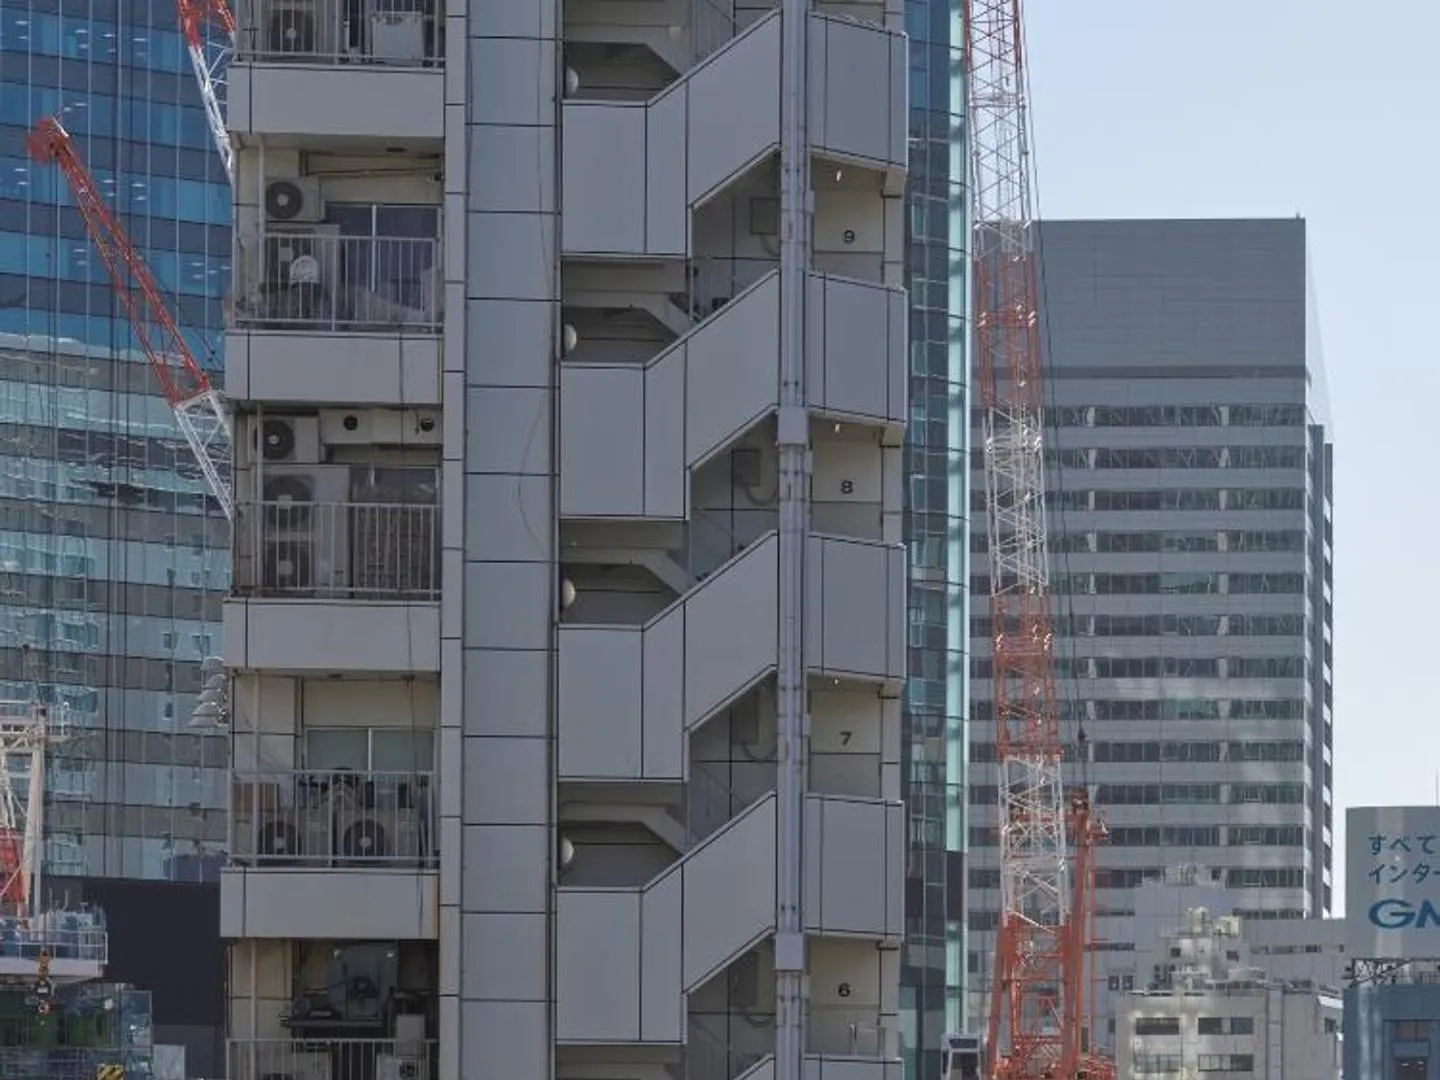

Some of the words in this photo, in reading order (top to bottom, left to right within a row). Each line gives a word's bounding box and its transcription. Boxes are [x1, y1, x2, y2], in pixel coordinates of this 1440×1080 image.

[843, 229, 855, 243] 9
[841, 479, 853, 495] 8
[840, 731, 852, 746] 7
[838, 983, 851, 998] 6
